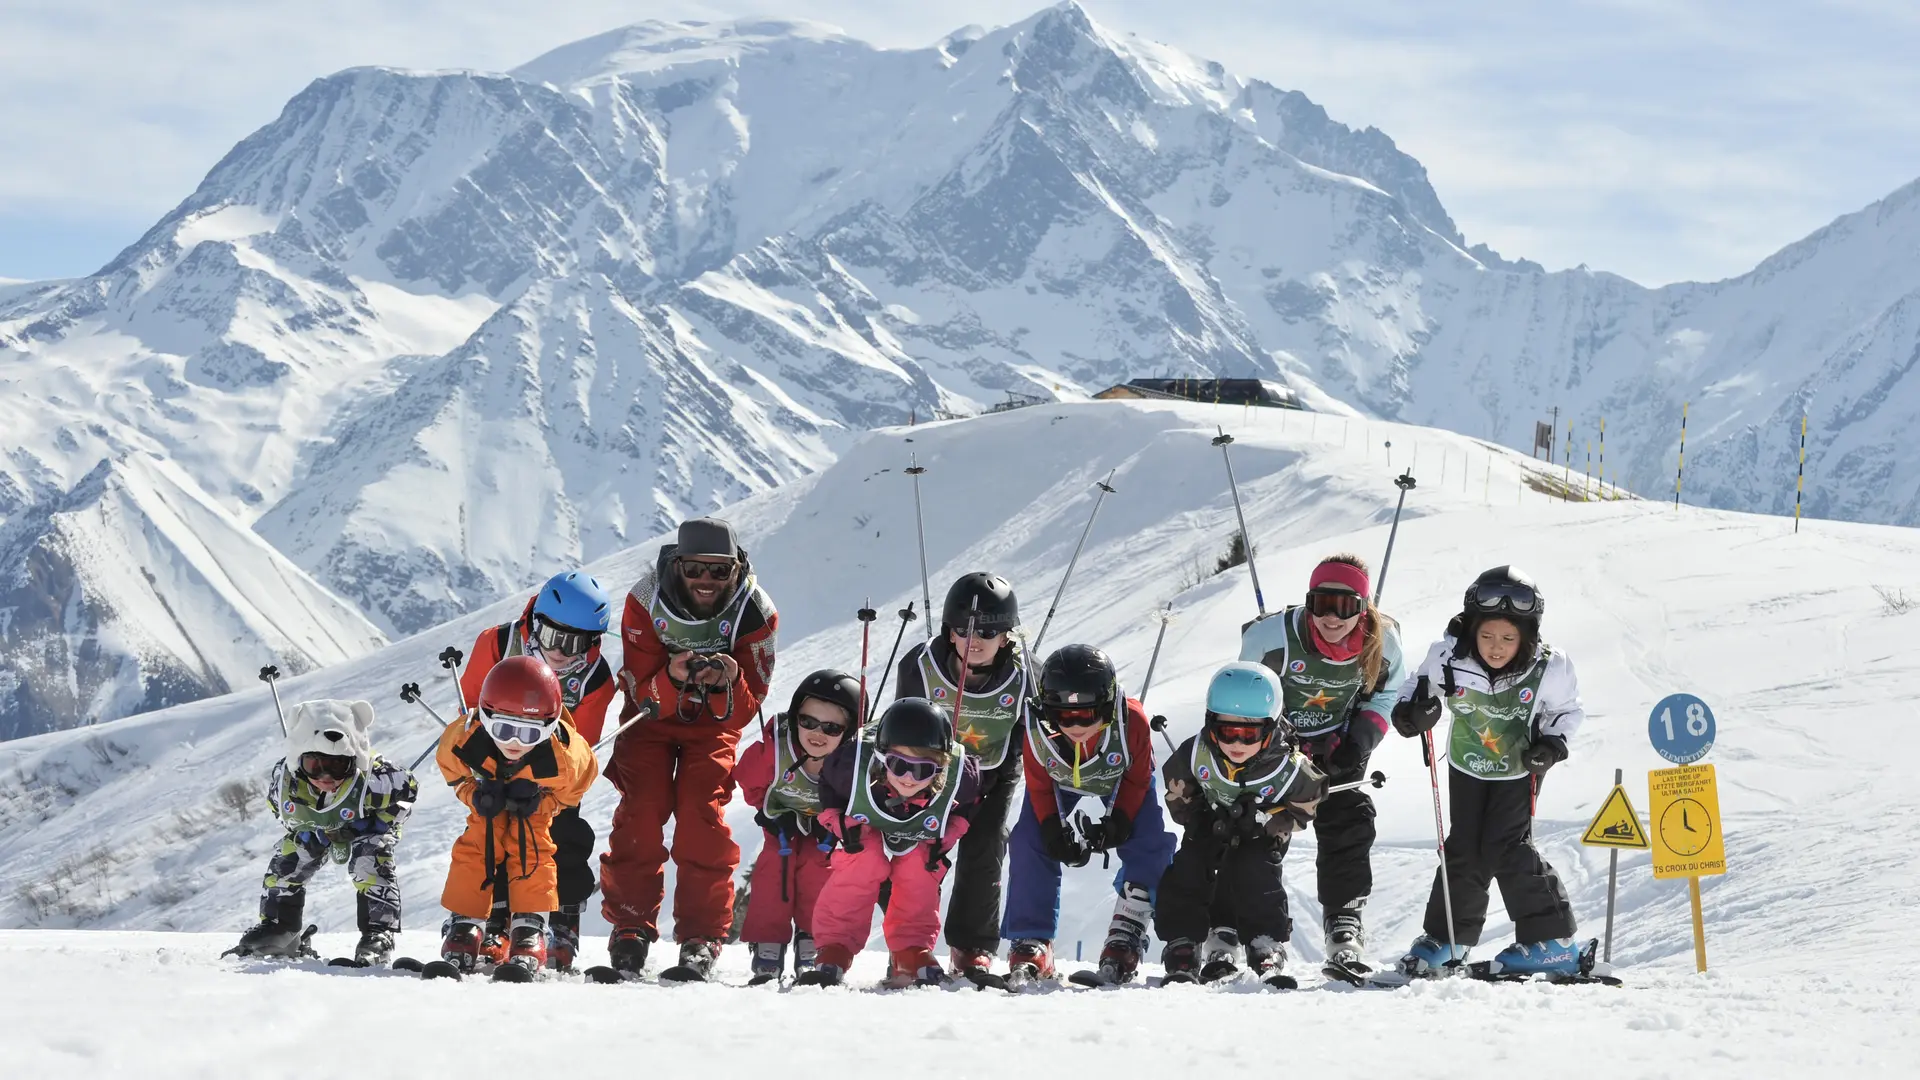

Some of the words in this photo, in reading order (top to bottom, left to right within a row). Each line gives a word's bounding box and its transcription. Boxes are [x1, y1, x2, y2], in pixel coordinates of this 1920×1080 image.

[1661, 703, 1708, 740] 18
[1660, 741, 1712, 763] CLEMENTINES
[1653, 782, 1675, 791] LETZTE
[1676, 779, 1711, 788] BERGFAHRT
[1662, 775, 1677, 783] LAST
[1661, 788, 1683, 796] ULTIMA
[1683, 786, 1705, 794] SALITA
[1654, 865, 1664, 874] TS
[1665, 864, 1687, 872] CROIX
[1699, 860, 1725, 870] CHRIST
